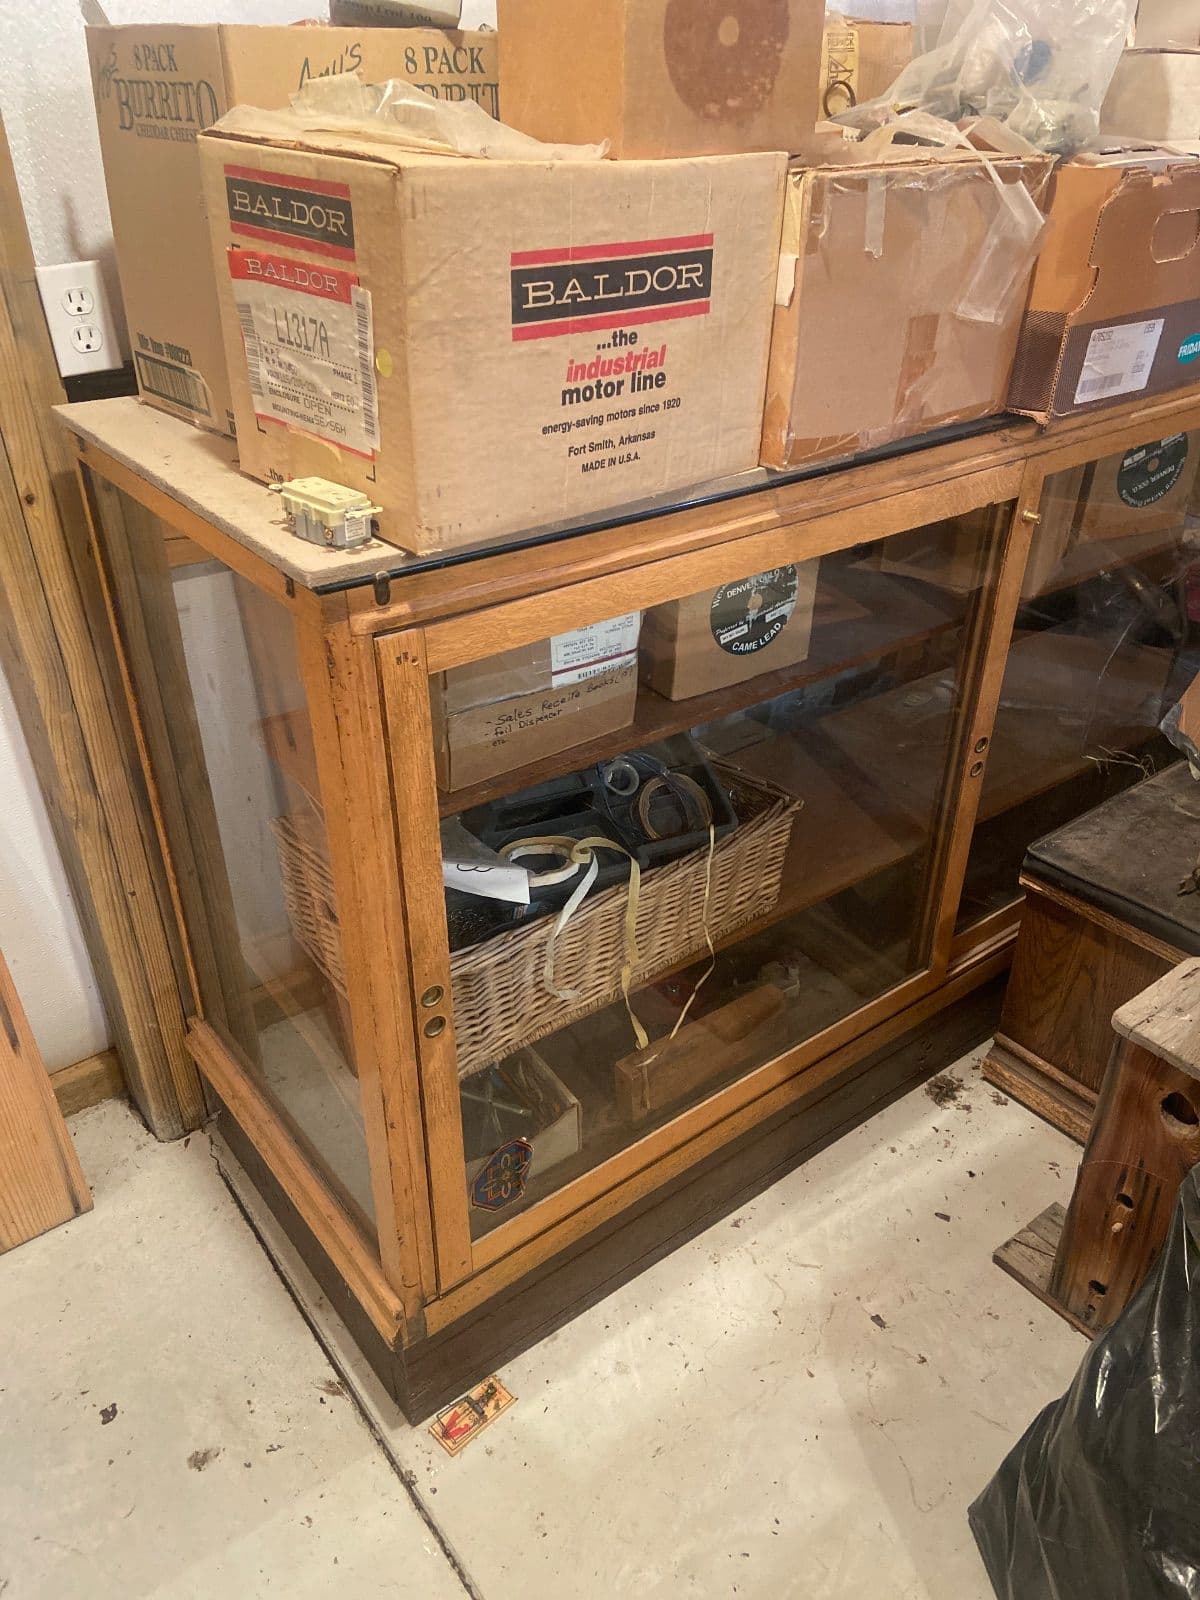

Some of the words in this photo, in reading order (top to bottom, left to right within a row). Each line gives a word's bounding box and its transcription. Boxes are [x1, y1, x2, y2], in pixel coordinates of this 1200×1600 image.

[134, 44, 143, 72] 8
[142, 44, 179, 72] PACK
[404, 46, 418, 74] 8
[422, 46, 486, 74] PACK
[112, 79, 219, 131] BURRITO
[136, 123, 169, 140] CHEDDAR
[232, 190, 348, 236] BALDOR
[244, 258, 339, 294] BALDOR
[522, 263, 704, 309] BALDOR
[274, 308, 331, 357] L1317A
[566, 344, 667, 383] industrial
[561, 379, 624, 406] motor
[630, 370, 667, 394] line
[304, 398, 332, 416] OPEN
[541, 413, 604, 435] energy-saving
[606, 405, 636, 424] motors
[639, 400, 660, 415] since
[663, 397, 681, 410] 1920
[568, 443, 586, 457] Fort
[588, 438, 616, 453] Smith,
[618, 429, 656, 446] Arkansas
[581, 458, 606, 473] MADE
[608, 456, 616, 467] IN
[618, 451, 641, 465] U.S.A.
[732, 640, 758, 652] CAME
[759, 622, 781, 645] LEAD
[495, 708, 533, 726] Sales
